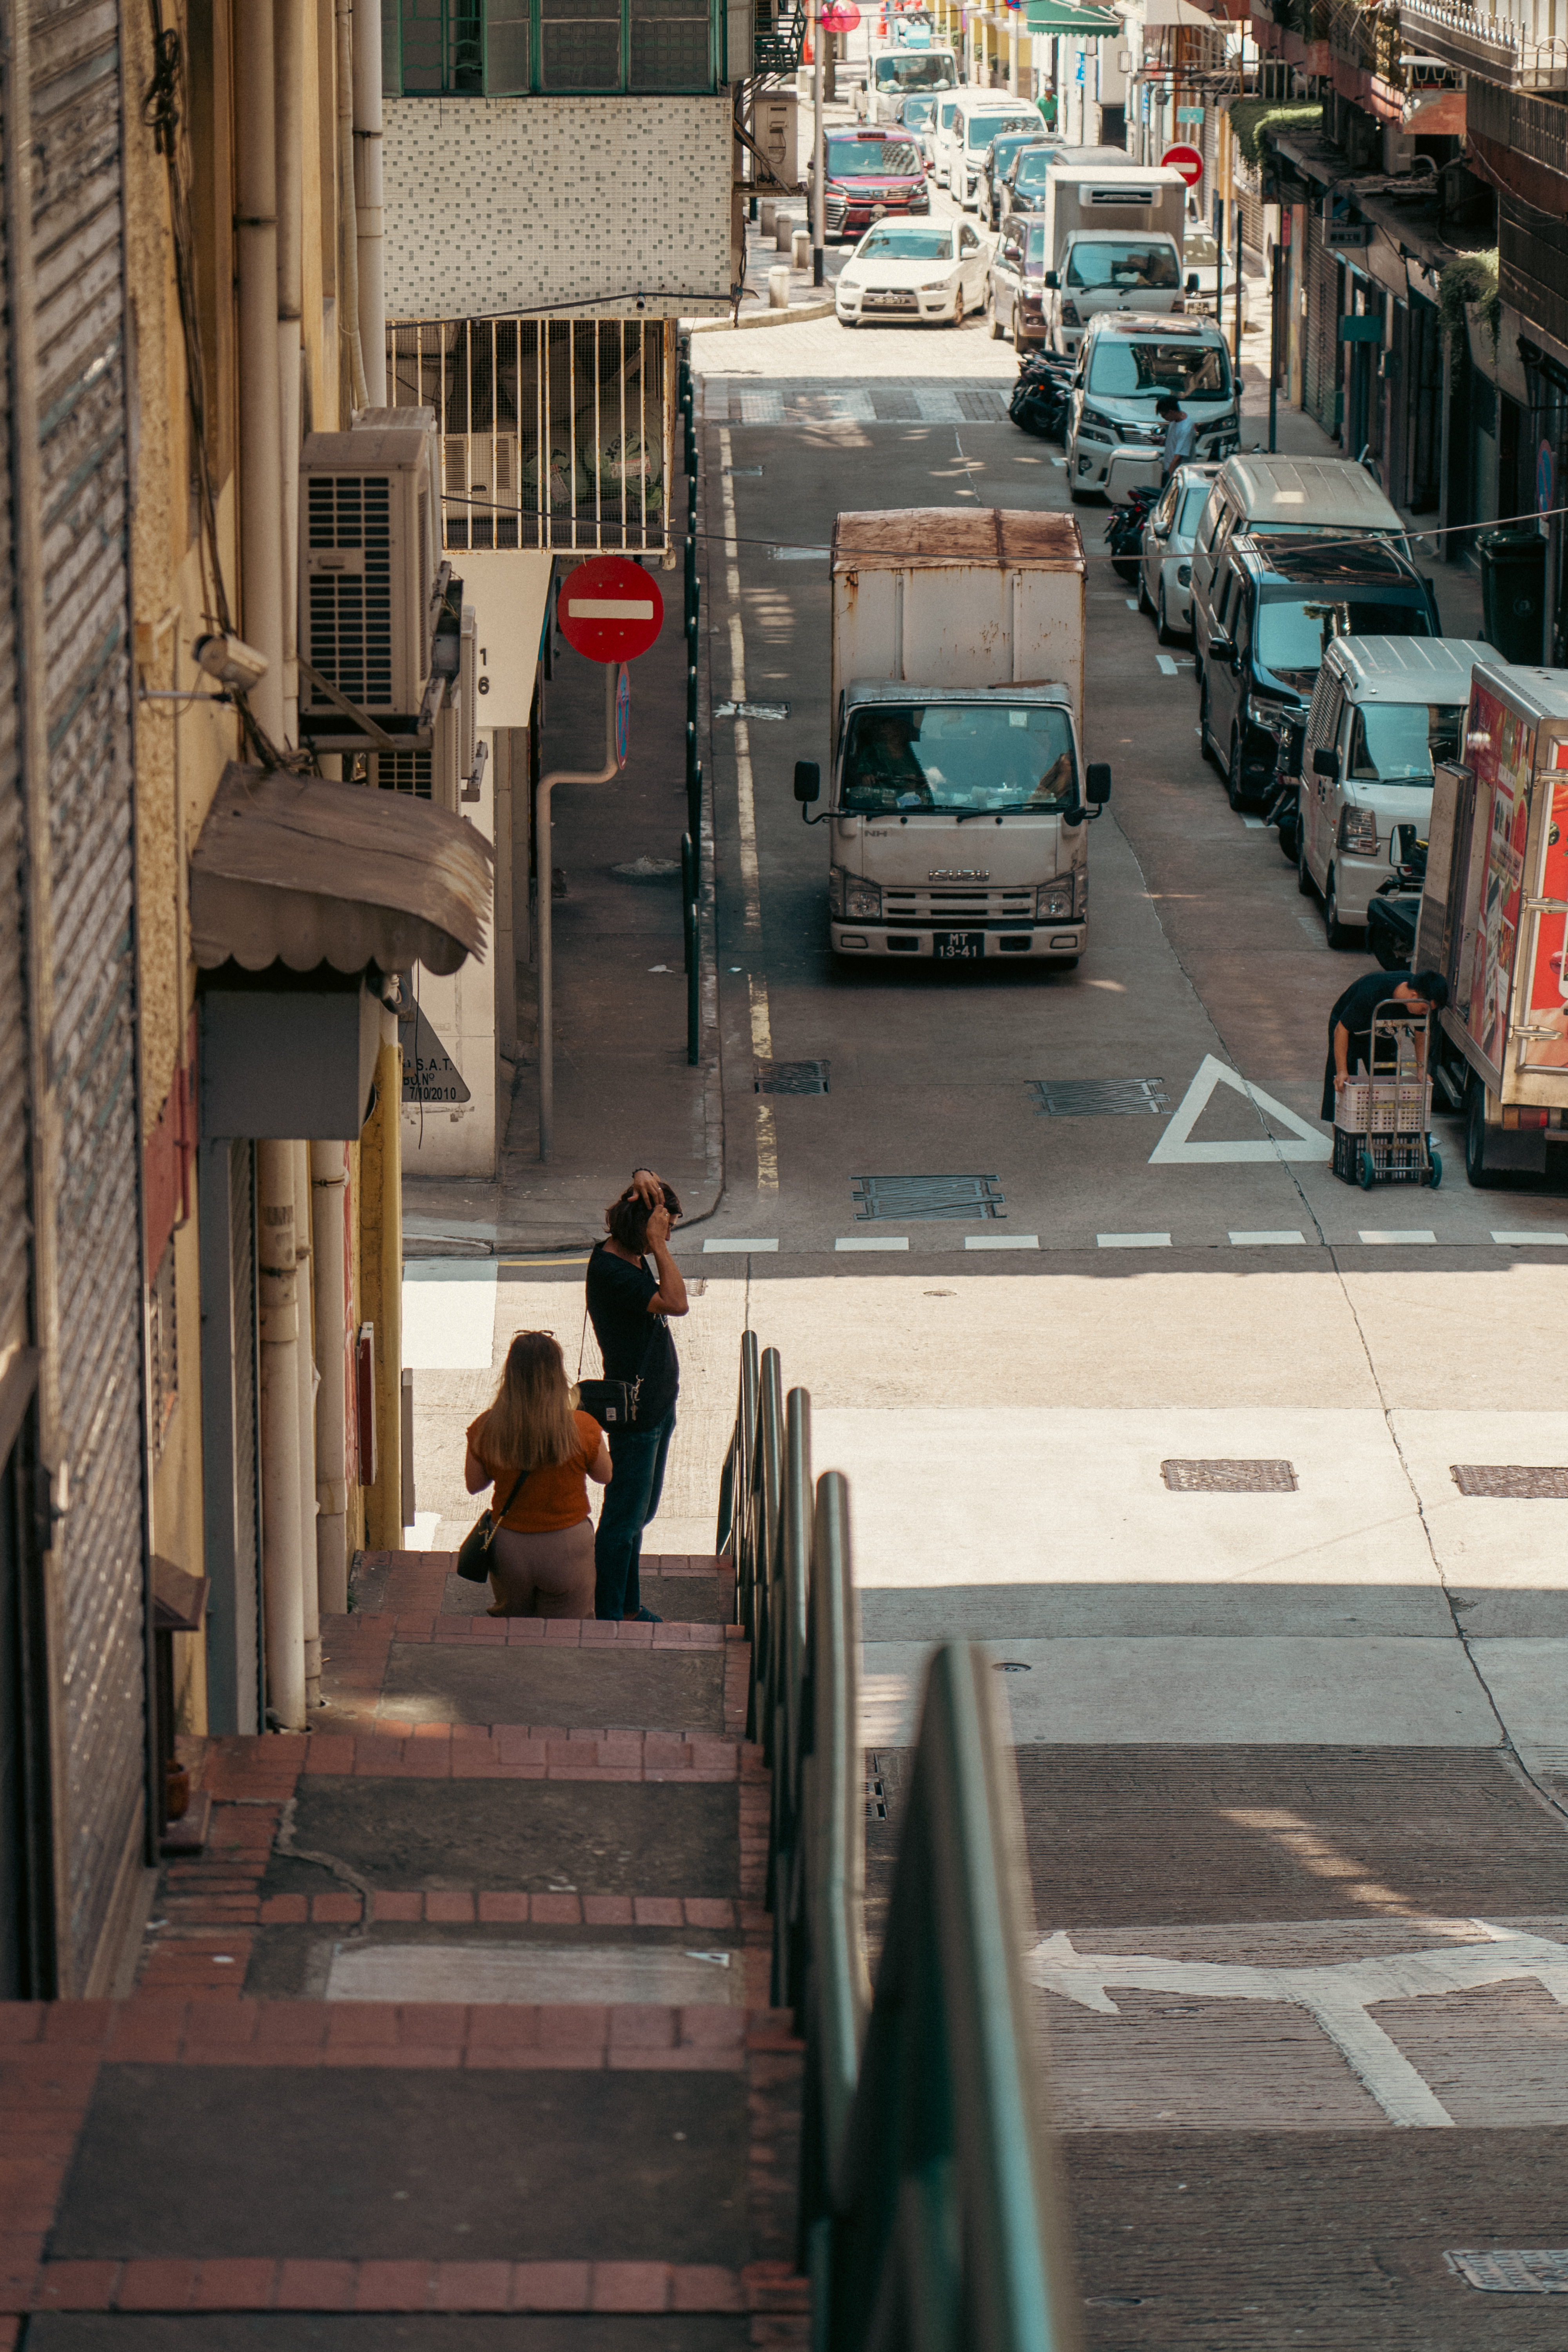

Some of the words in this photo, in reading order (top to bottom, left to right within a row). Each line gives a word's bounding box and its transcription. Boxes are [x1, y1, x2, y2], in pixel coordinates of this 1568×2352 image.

[929, 870, 989, 881] ISUZU
[950, 933, 968, 945] MT
[939, 945, 976, 957] 13-41
[410, 1087, 456, 1100] 7/10/2010
